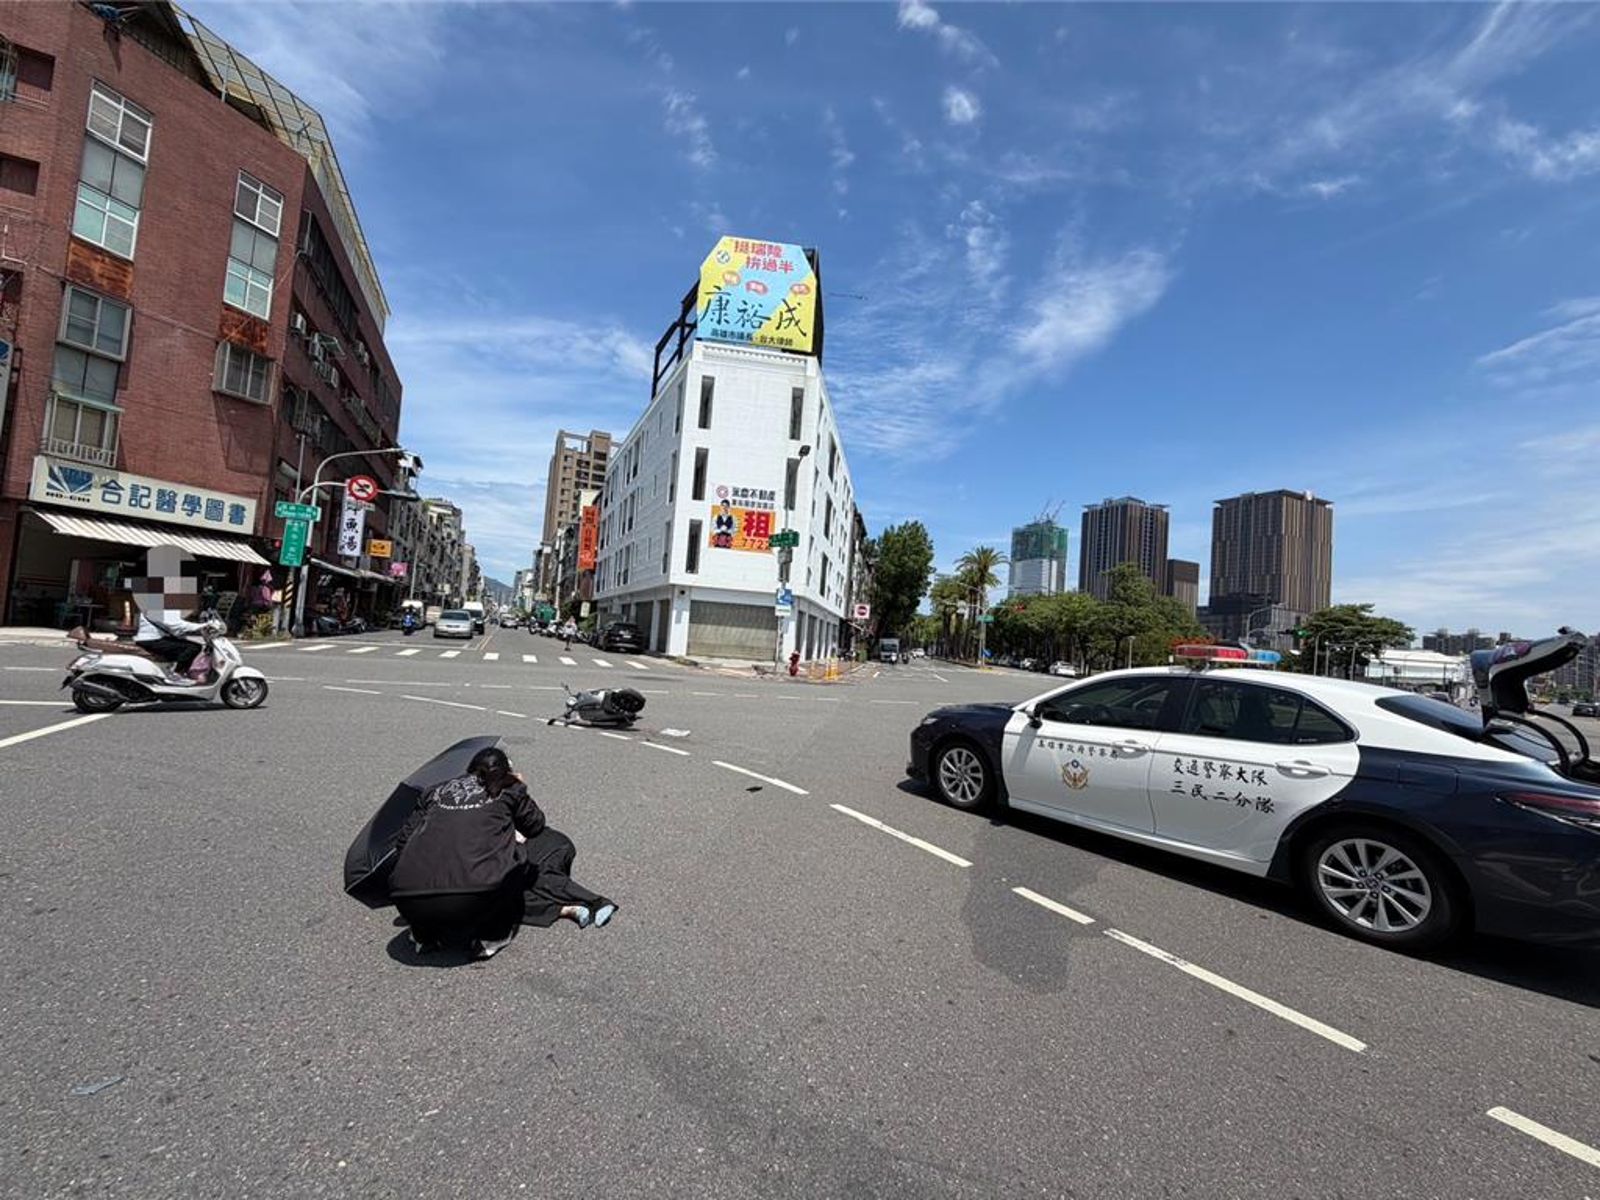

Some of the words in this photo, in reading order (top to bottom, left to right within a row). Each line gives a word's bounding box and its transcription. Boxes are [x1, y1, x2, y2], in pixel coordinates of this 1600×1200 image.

[701, 286, 807, 337] 康裕成
[101, 479, 246, 526] 合記醫學圖書
[743, 510, 770, 538] 租
[1172, 757, 1269, 787] 交通警察大隊
[1170, 780, 1276, 815] 三民二分隊
